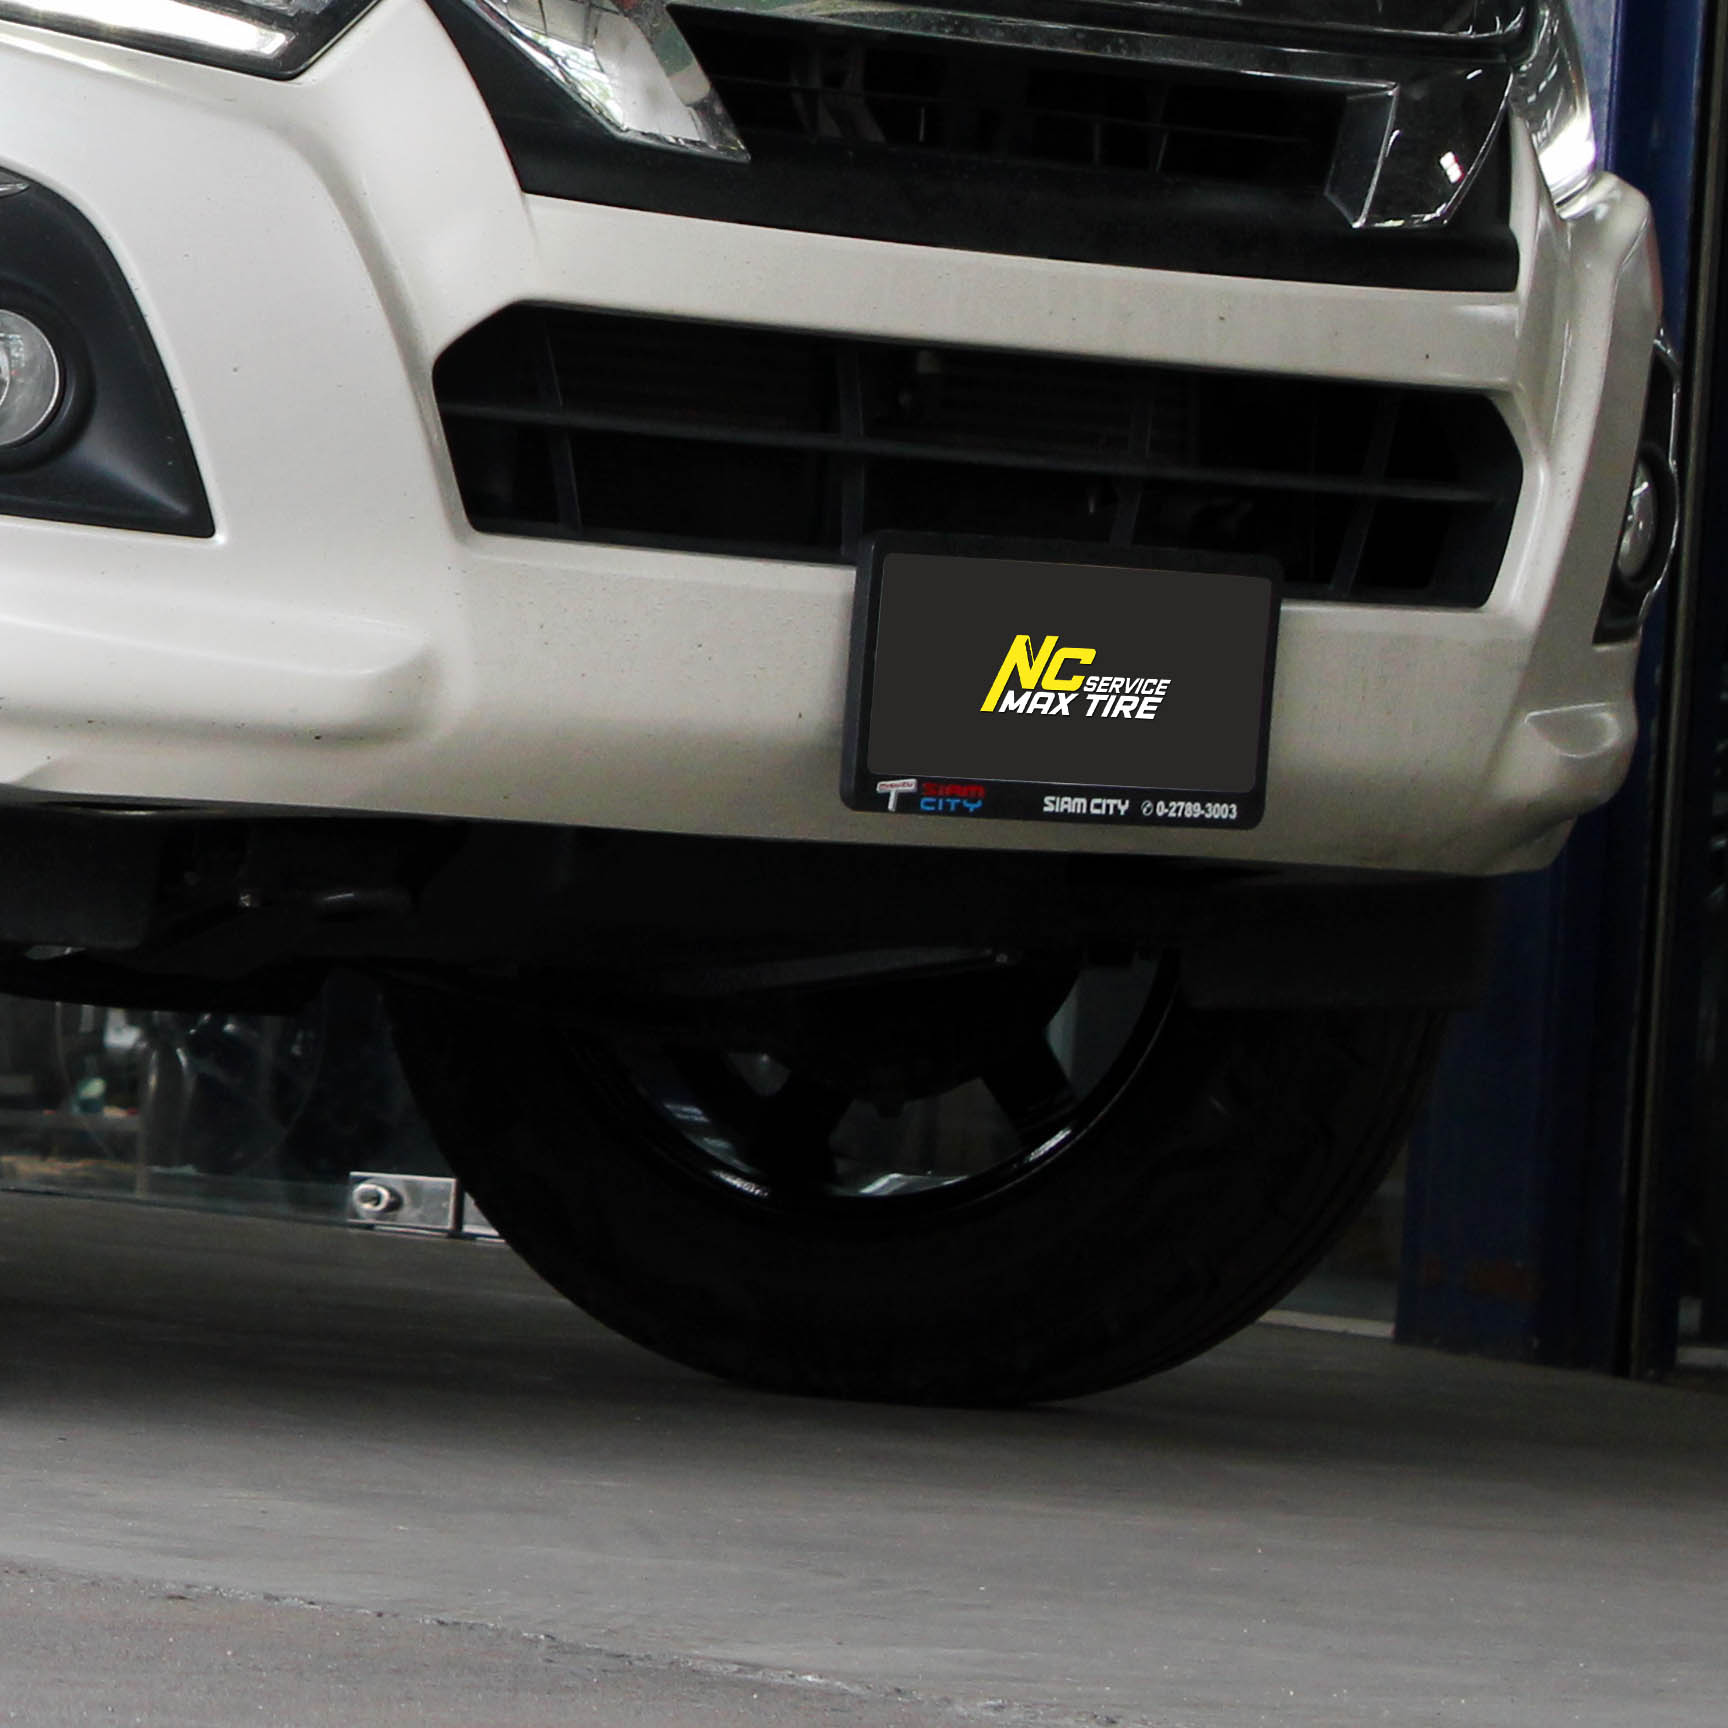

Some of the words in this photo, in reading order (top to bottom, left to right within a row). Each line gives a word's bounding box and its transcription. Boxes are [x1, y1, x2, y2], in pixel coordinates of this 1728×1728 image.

[919, 796, 984, 813] CITY
[1042, 795, 1088, 815] SIAM
[1089, 798, 1130, 817] CITY
[1155, 801, 1238, 821] 0-2789-3003
